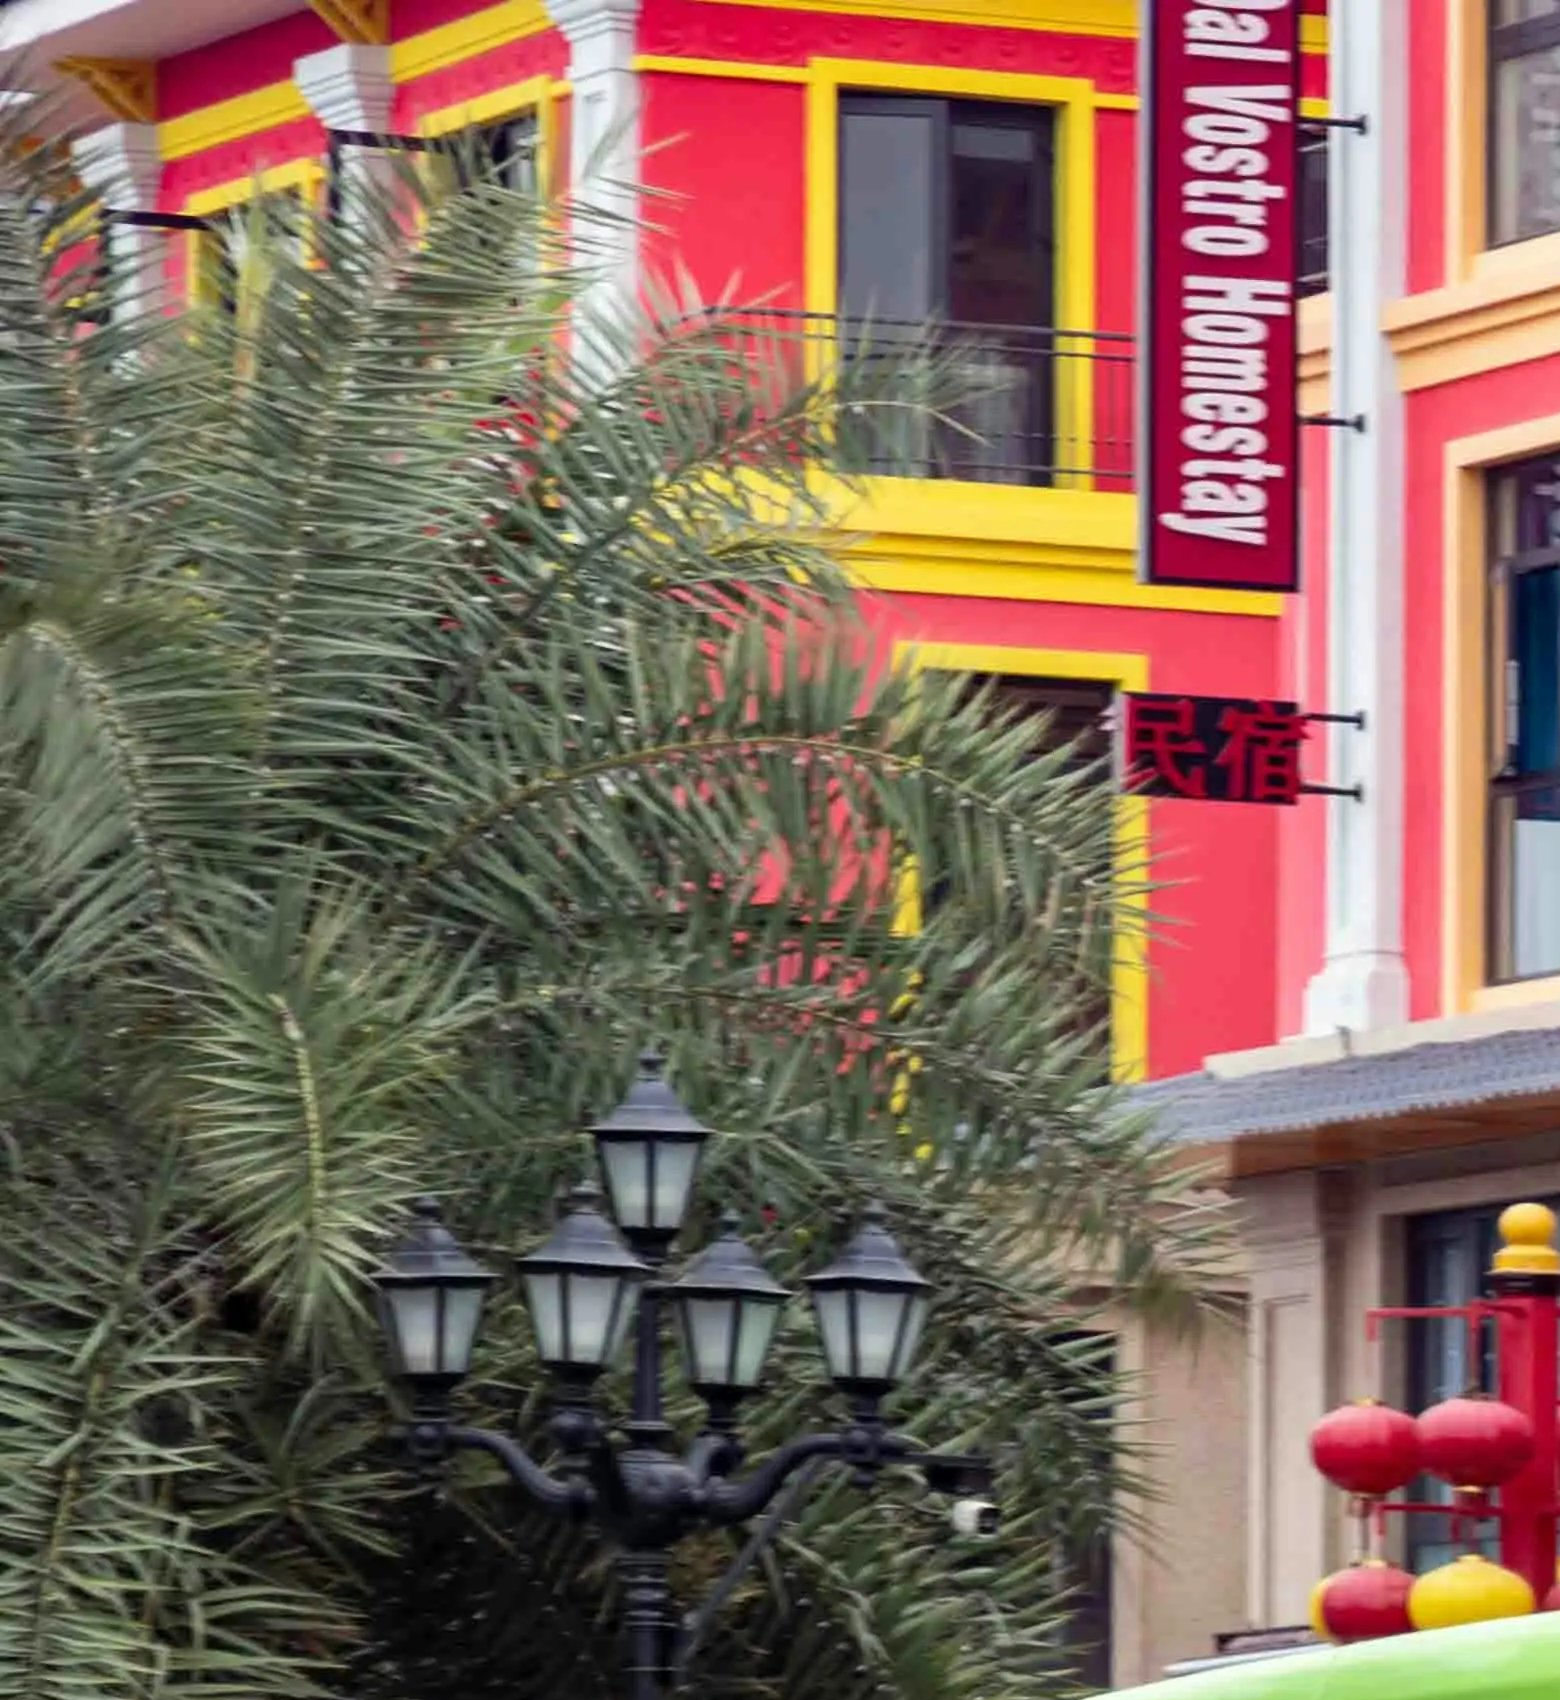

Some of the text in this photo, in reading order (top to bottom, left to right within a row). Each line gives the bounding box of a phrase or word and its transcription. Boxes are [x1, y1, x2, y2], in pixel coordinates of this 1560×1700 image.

[1158, 0, 1292, 546] al Vostro Homestay
[1122, 699, 1312, 806] 民宿
